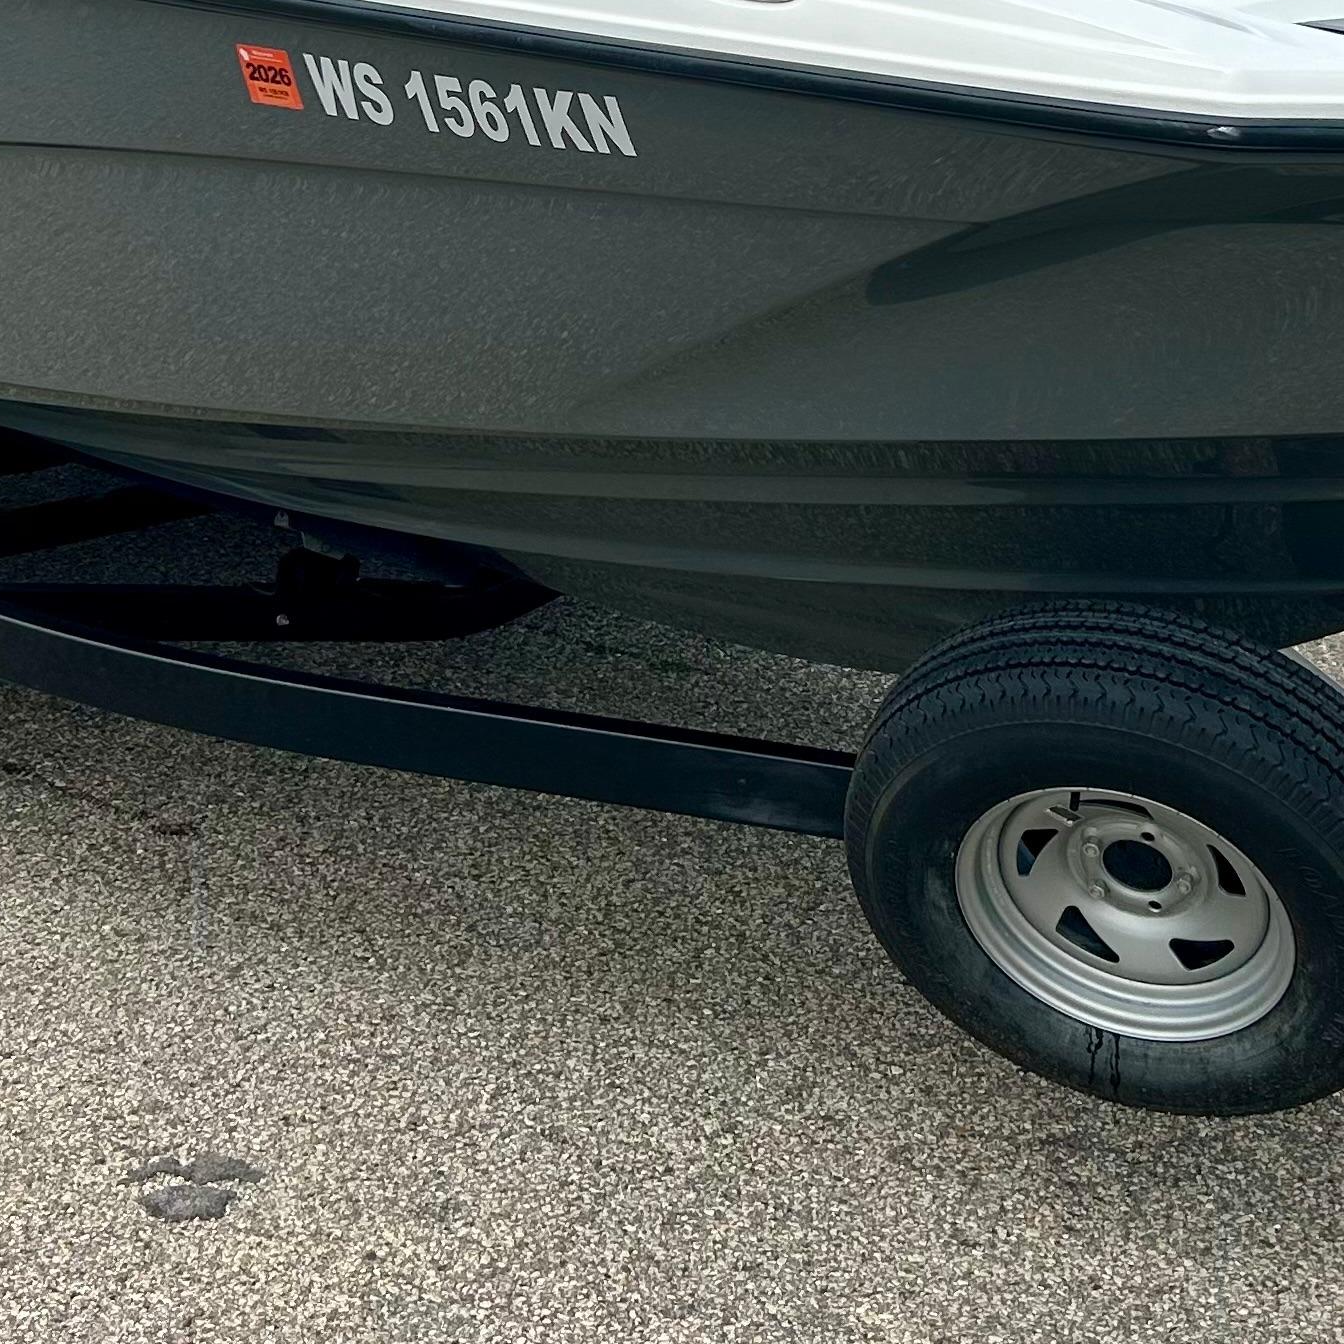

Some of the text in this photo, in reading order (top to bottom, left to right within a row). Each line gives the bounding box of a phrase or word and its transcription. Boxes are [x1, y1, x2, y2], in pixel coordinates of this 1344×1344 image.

[246, 62, 292, 87] 2026
[302, 53, 637, 157] WS 1561KN
